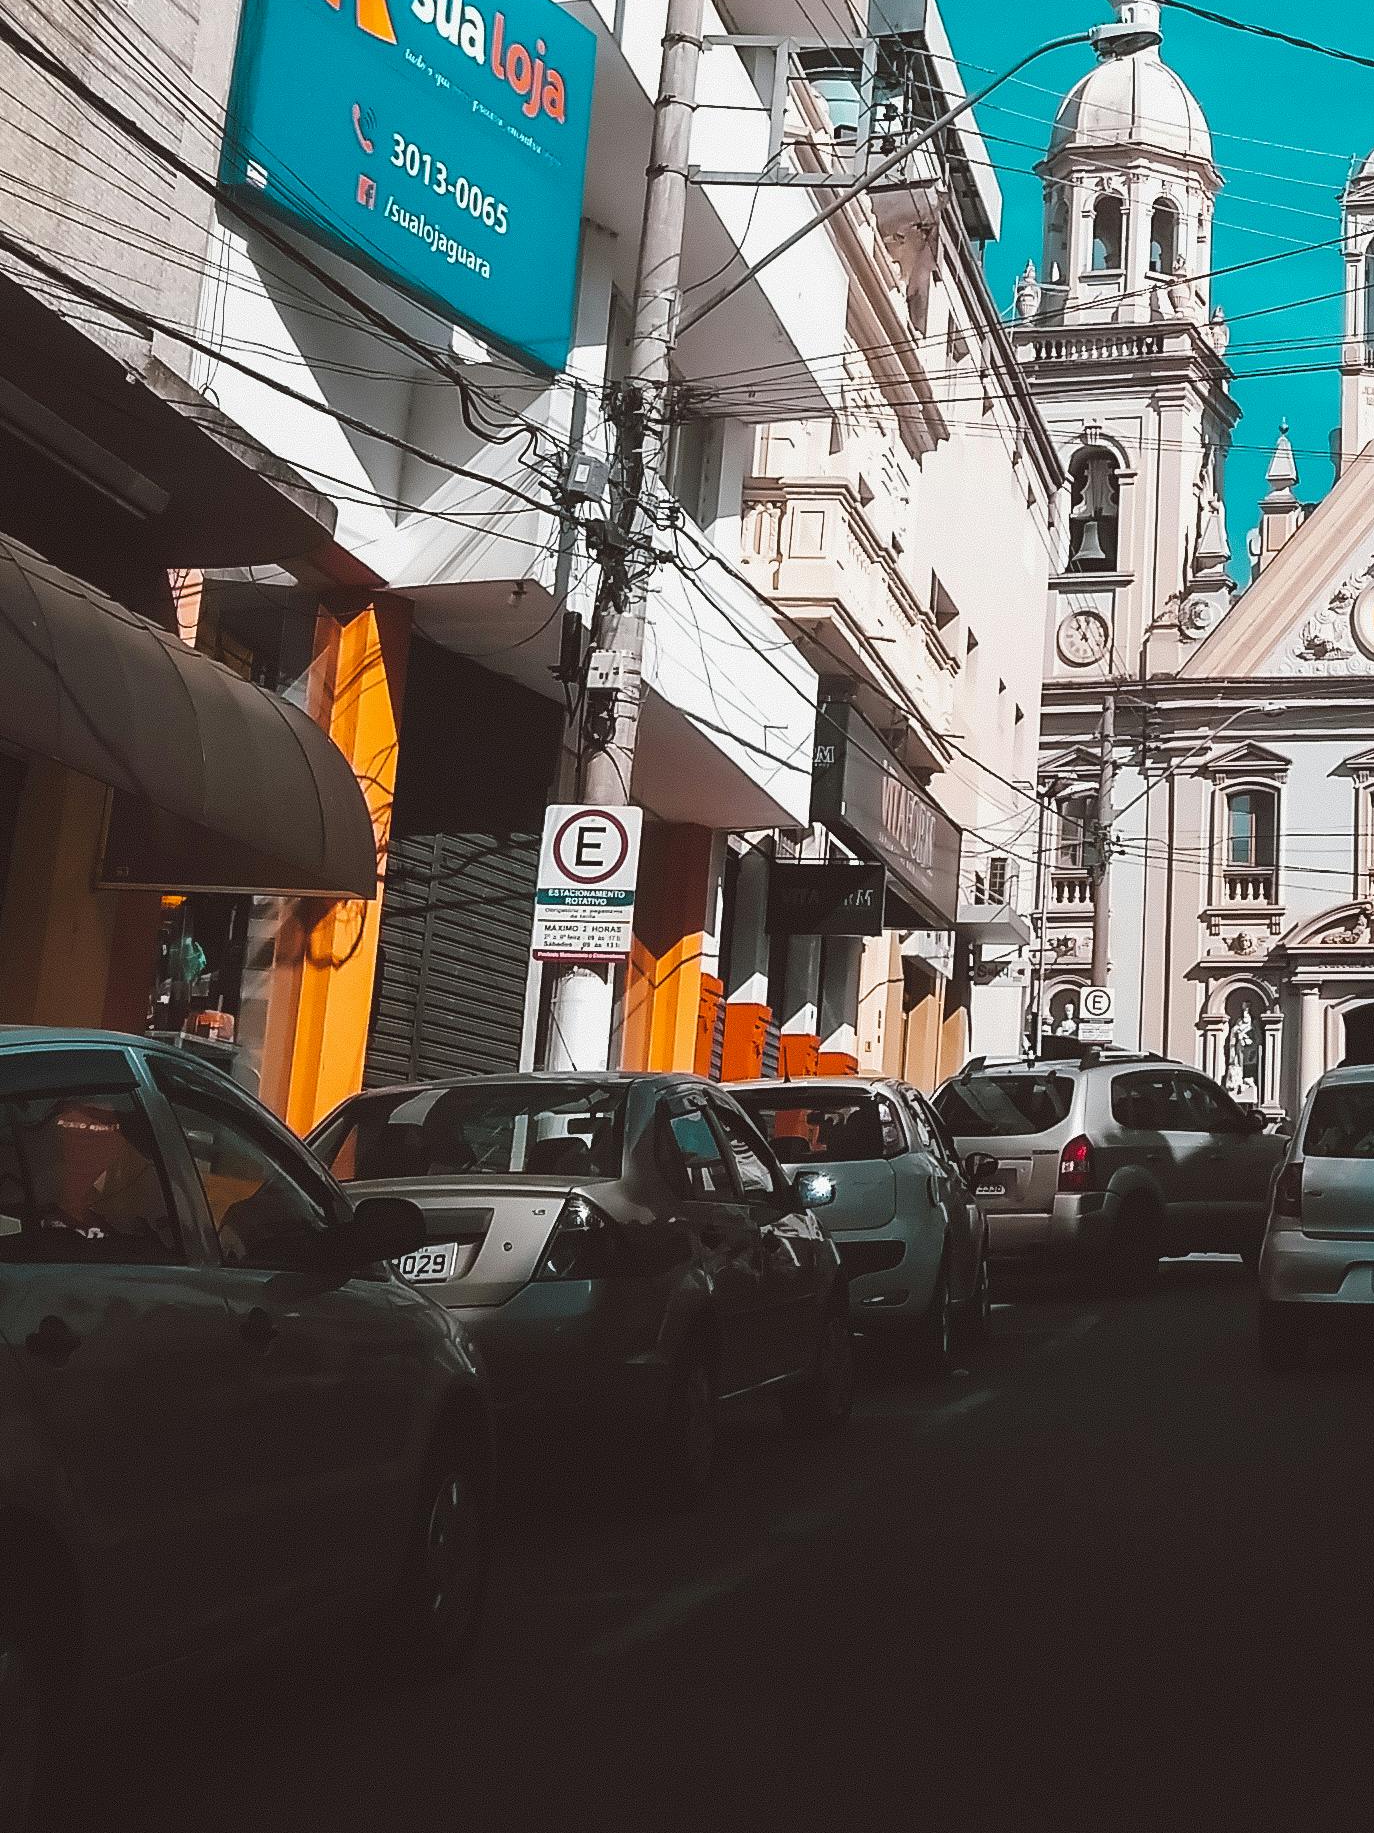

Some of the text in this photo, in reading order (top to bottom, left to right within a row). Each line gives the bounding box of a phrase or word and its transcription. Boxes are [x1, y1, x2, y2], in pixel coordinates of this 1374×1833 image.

[491, 11, 566, 125] loja
[390, 132, 509, 235] 3013-0065
[384, 195, 491, 280] /sualojaguara
[575, 826, 606, 866] E
[548, 889, 626, 899] ESTACIONAMENTO
[565, 897, 608, 906] ROTATIVO
[1092, 994, 1104, 1010] E
[390, 1253, 447, 1275] 029
